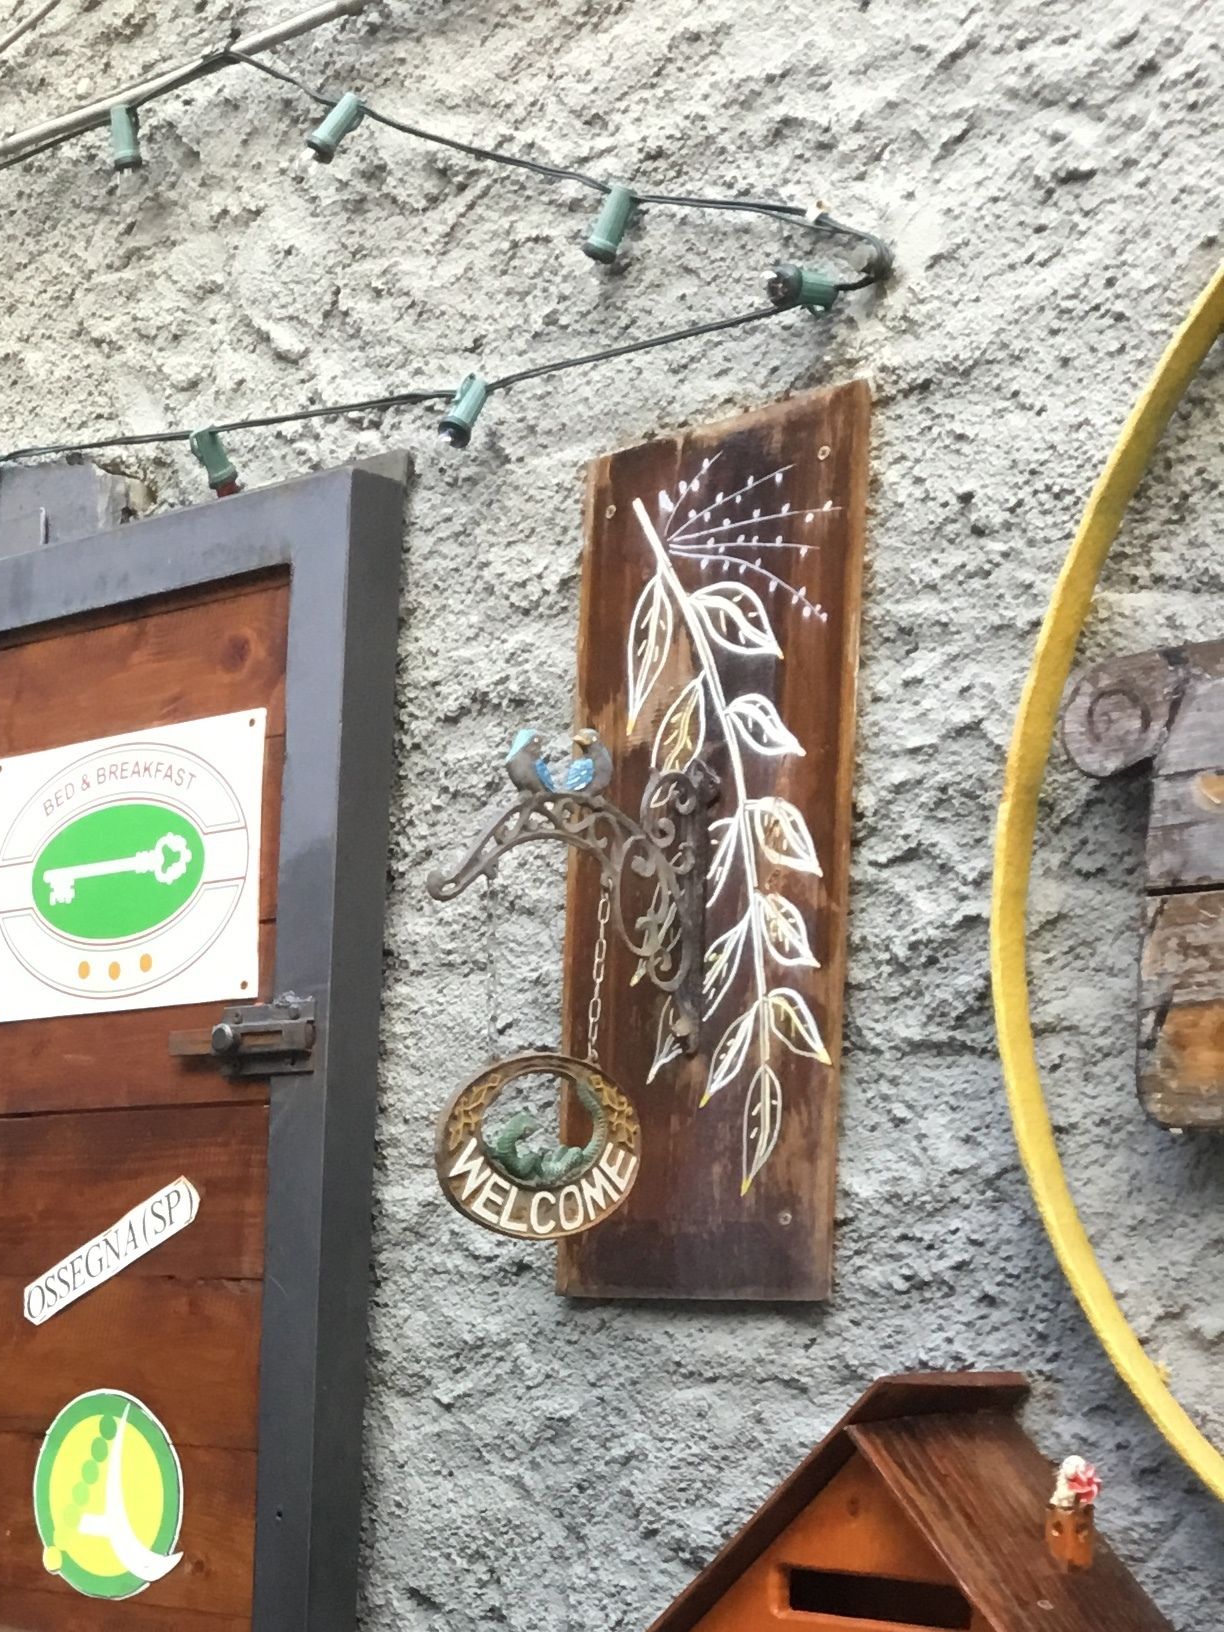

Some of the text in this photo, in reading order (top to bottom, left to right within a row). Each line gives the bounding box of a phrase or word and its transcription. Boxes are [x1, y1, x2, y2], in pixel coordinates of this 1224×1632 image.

[42, 760, 197, 817] BED & BREAKFAST
[448, 1137, 638, 1235] WELCOME
